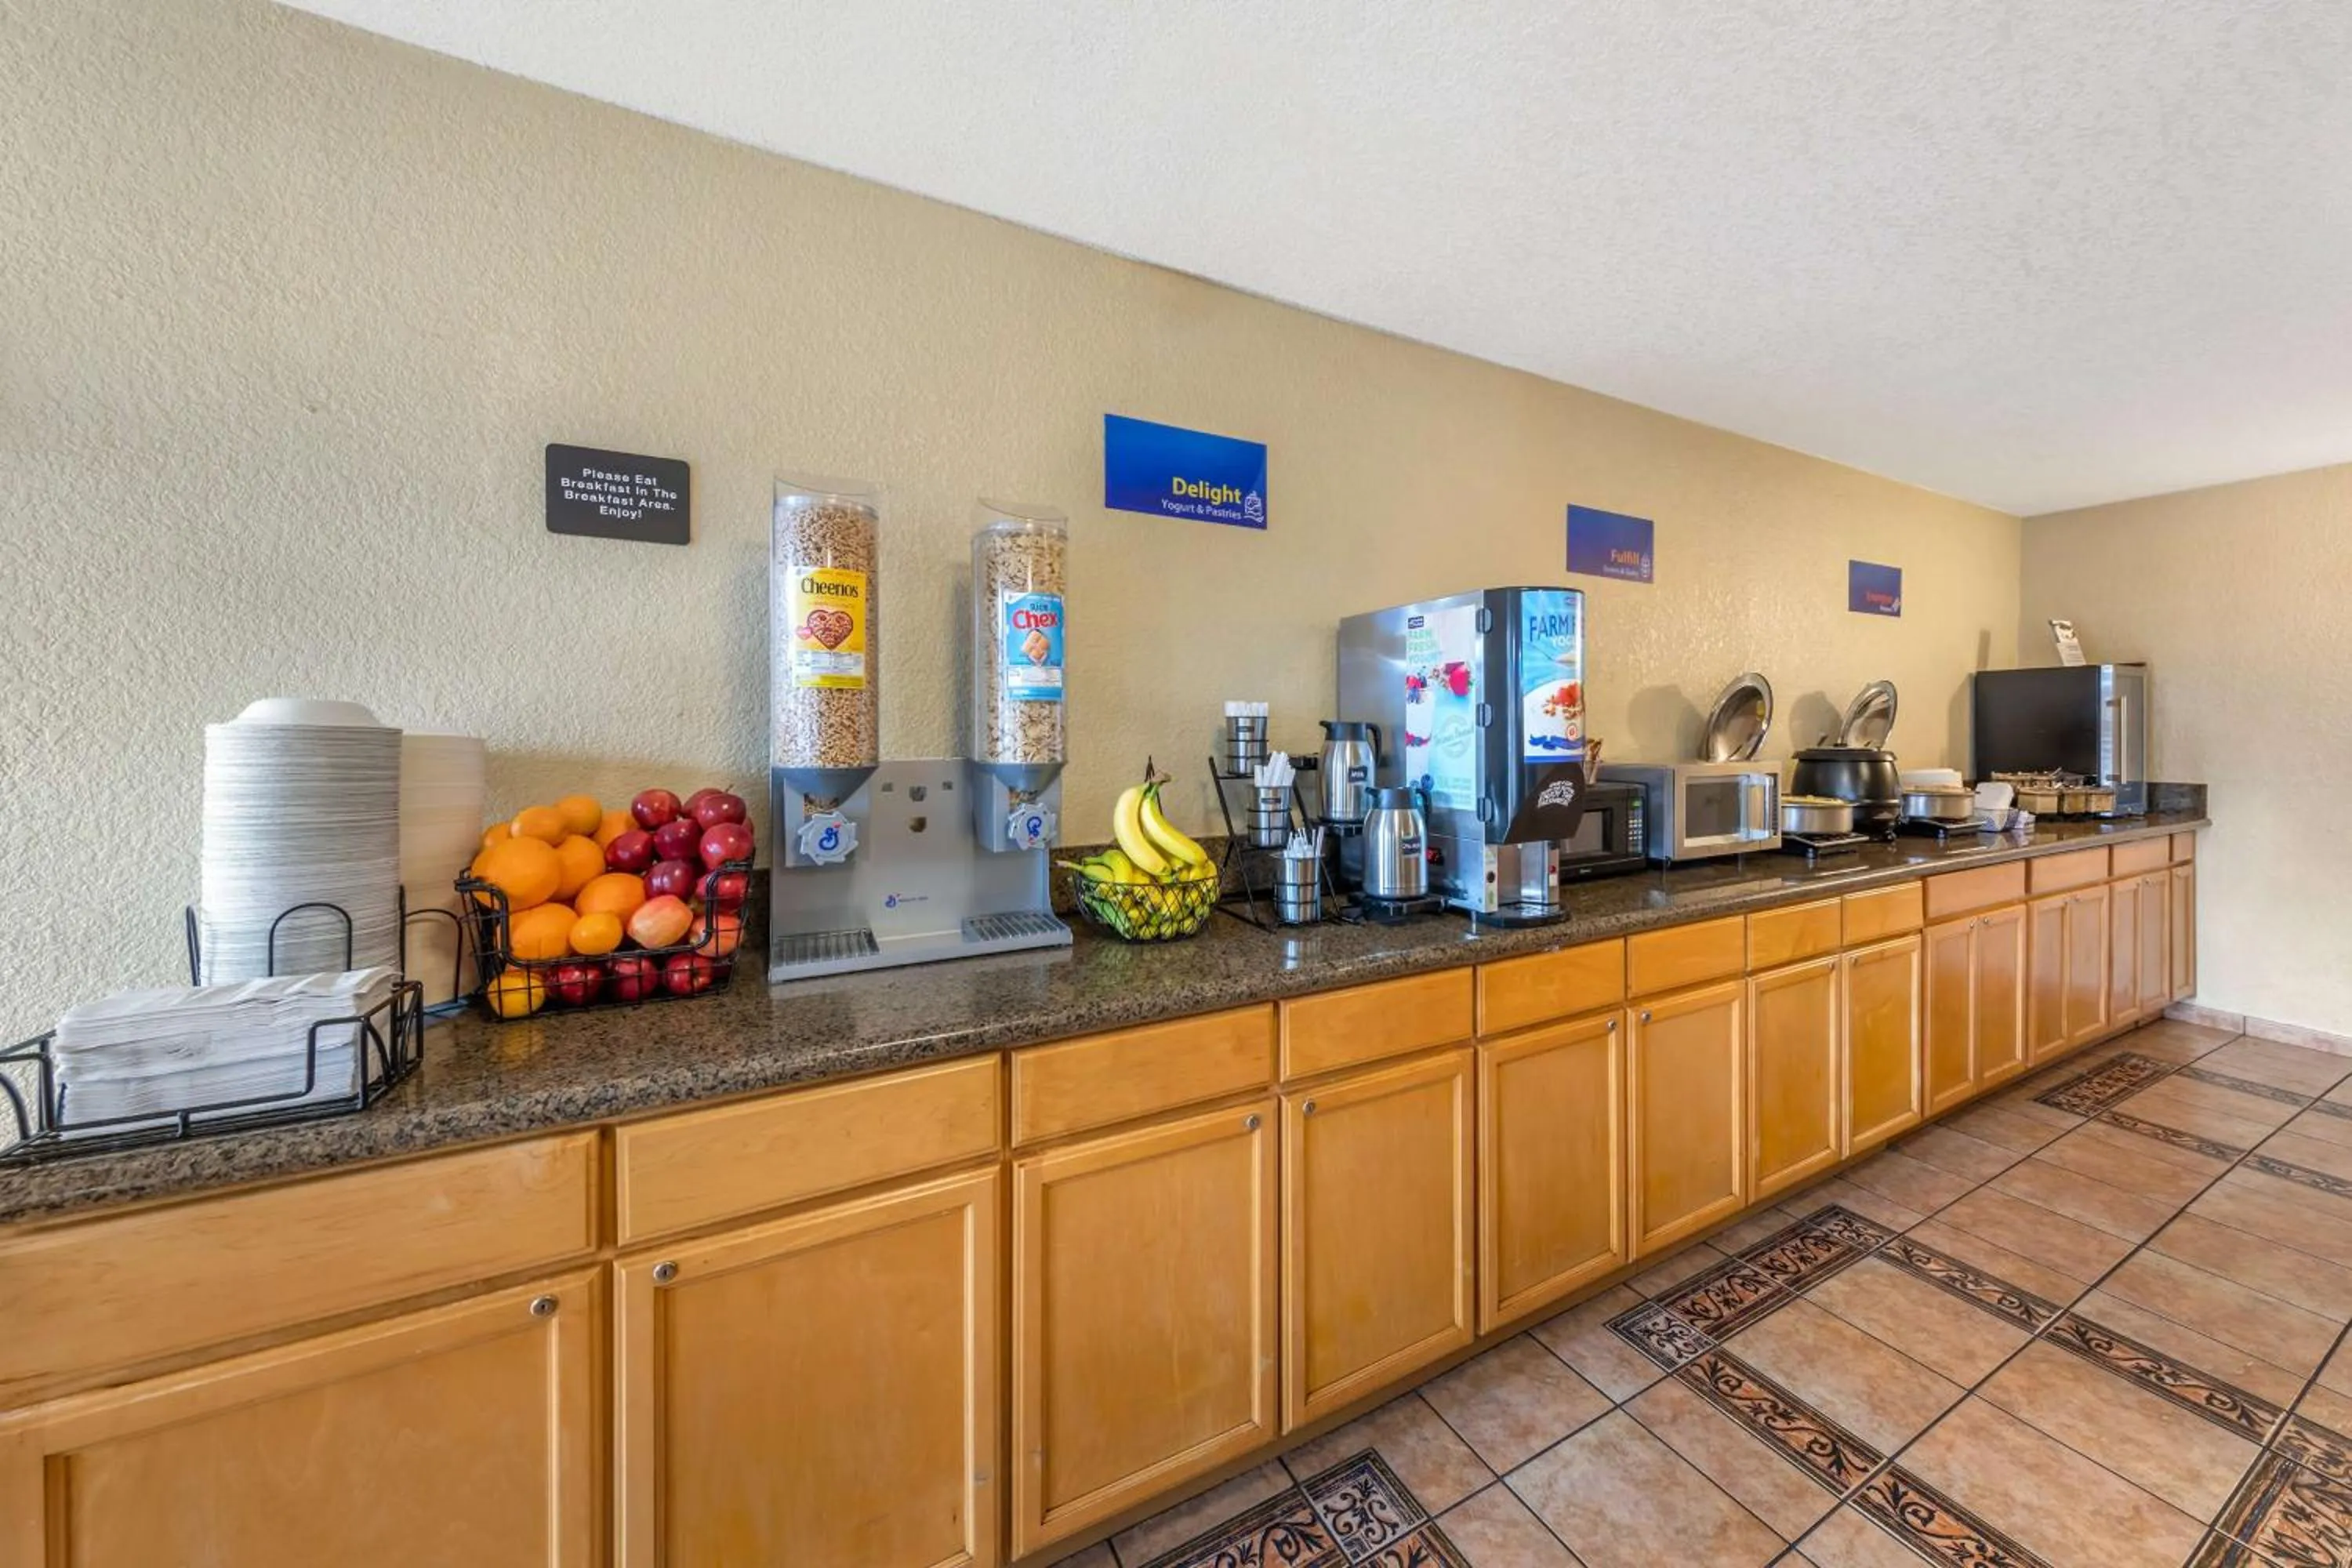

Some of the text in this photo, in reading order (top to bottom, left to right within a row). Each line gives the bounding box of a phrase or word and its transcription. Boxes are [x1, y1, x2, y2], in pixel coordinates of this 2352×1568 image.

[583, 468, 657, 486] Please Eat
[561, 477, 677, 500] Breakfast In The
[1172, 476, 1242, 506] Delight
[564, 490, 675, 511] Breakfast Area.
[1161, 498, 1242, 521] Yogurt & Pastries
[600, 506, 642, 519] Enjoy!
[800, 576, 858, 598] Cheerios
[1012, 608, 1058, 630] Chex
[1530, 614, 1569, 642] FARM
